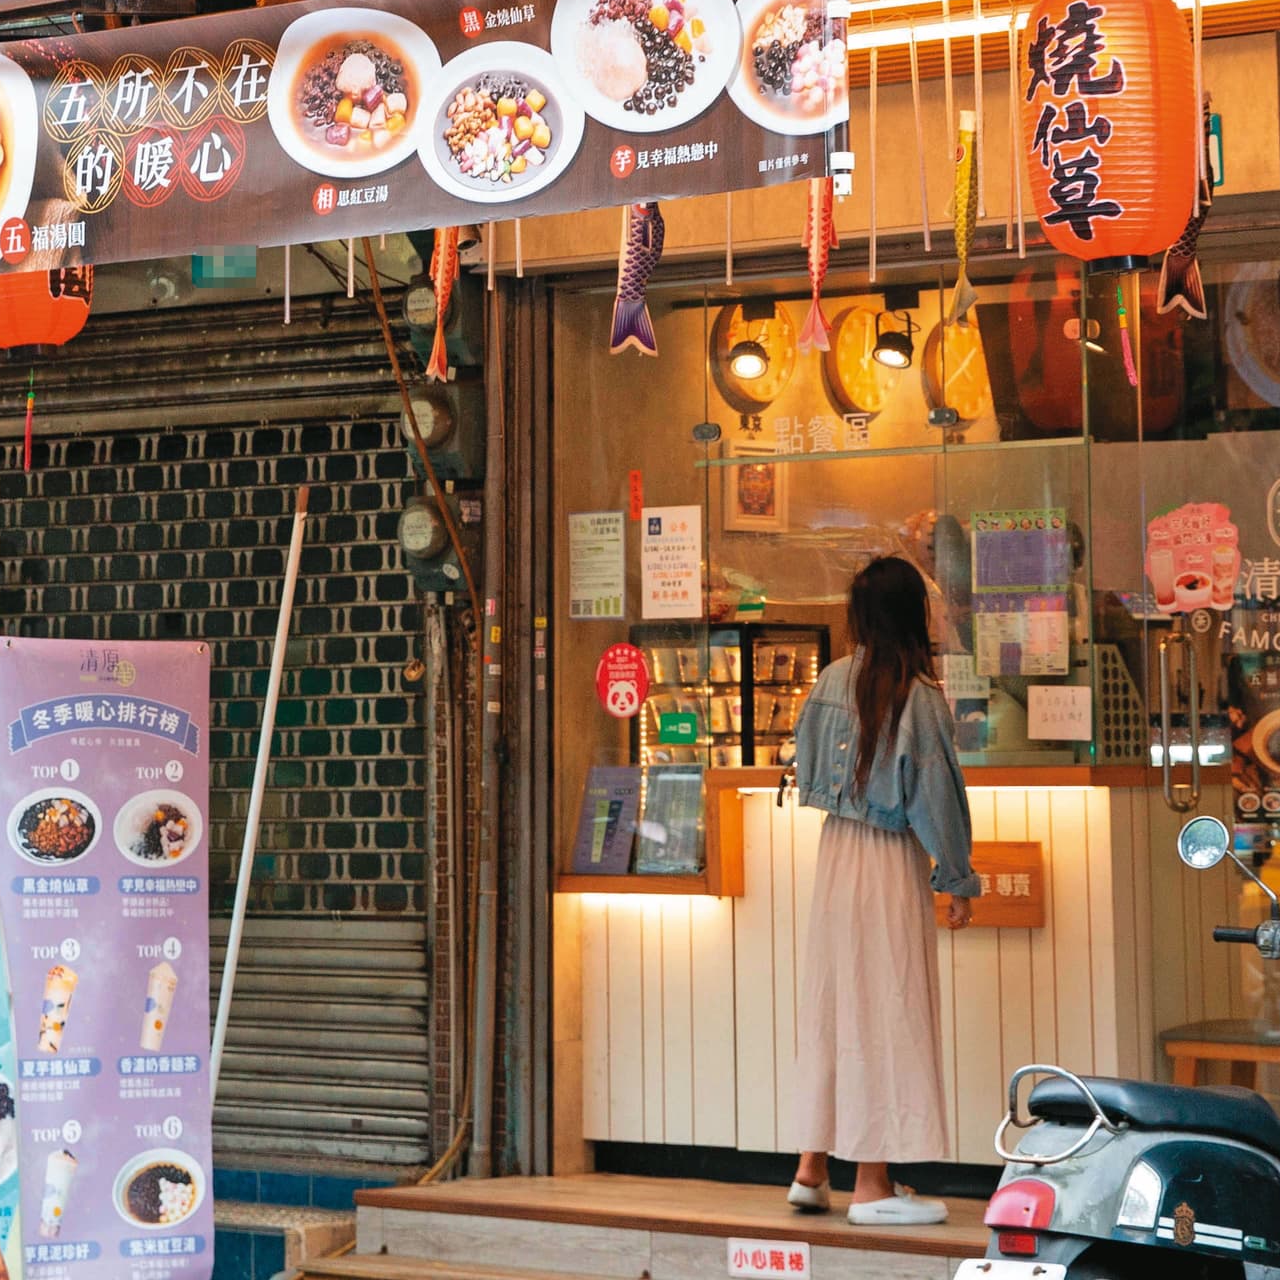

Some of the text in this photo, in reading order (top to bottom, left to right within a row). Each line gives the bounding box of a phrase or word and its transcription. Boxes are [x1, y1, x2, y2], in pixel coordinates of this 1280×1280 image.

[53, 53, 268, 126] 五所不在
[1025, 1, 1125, 240] 燒仙草
[74, 132, 232, 197] 的暖心
[316, 184, 389, 211] 相思紅豆湯
[4, 221, 86, 253] 五福湯圓
[774, 412, 871, 454] 點餐區
[32, 699, 181, 735] 冬季暖心排行榜
[32, 766, 59, 779] TOP
[136, 766, 163, 779] TOP
[32, 946, 59, 959] TOP
[136, 944, 162, 958] TOP
[32, 1128, 61, 1142] TOP
[135, 1124, 162, 1138] TOP
